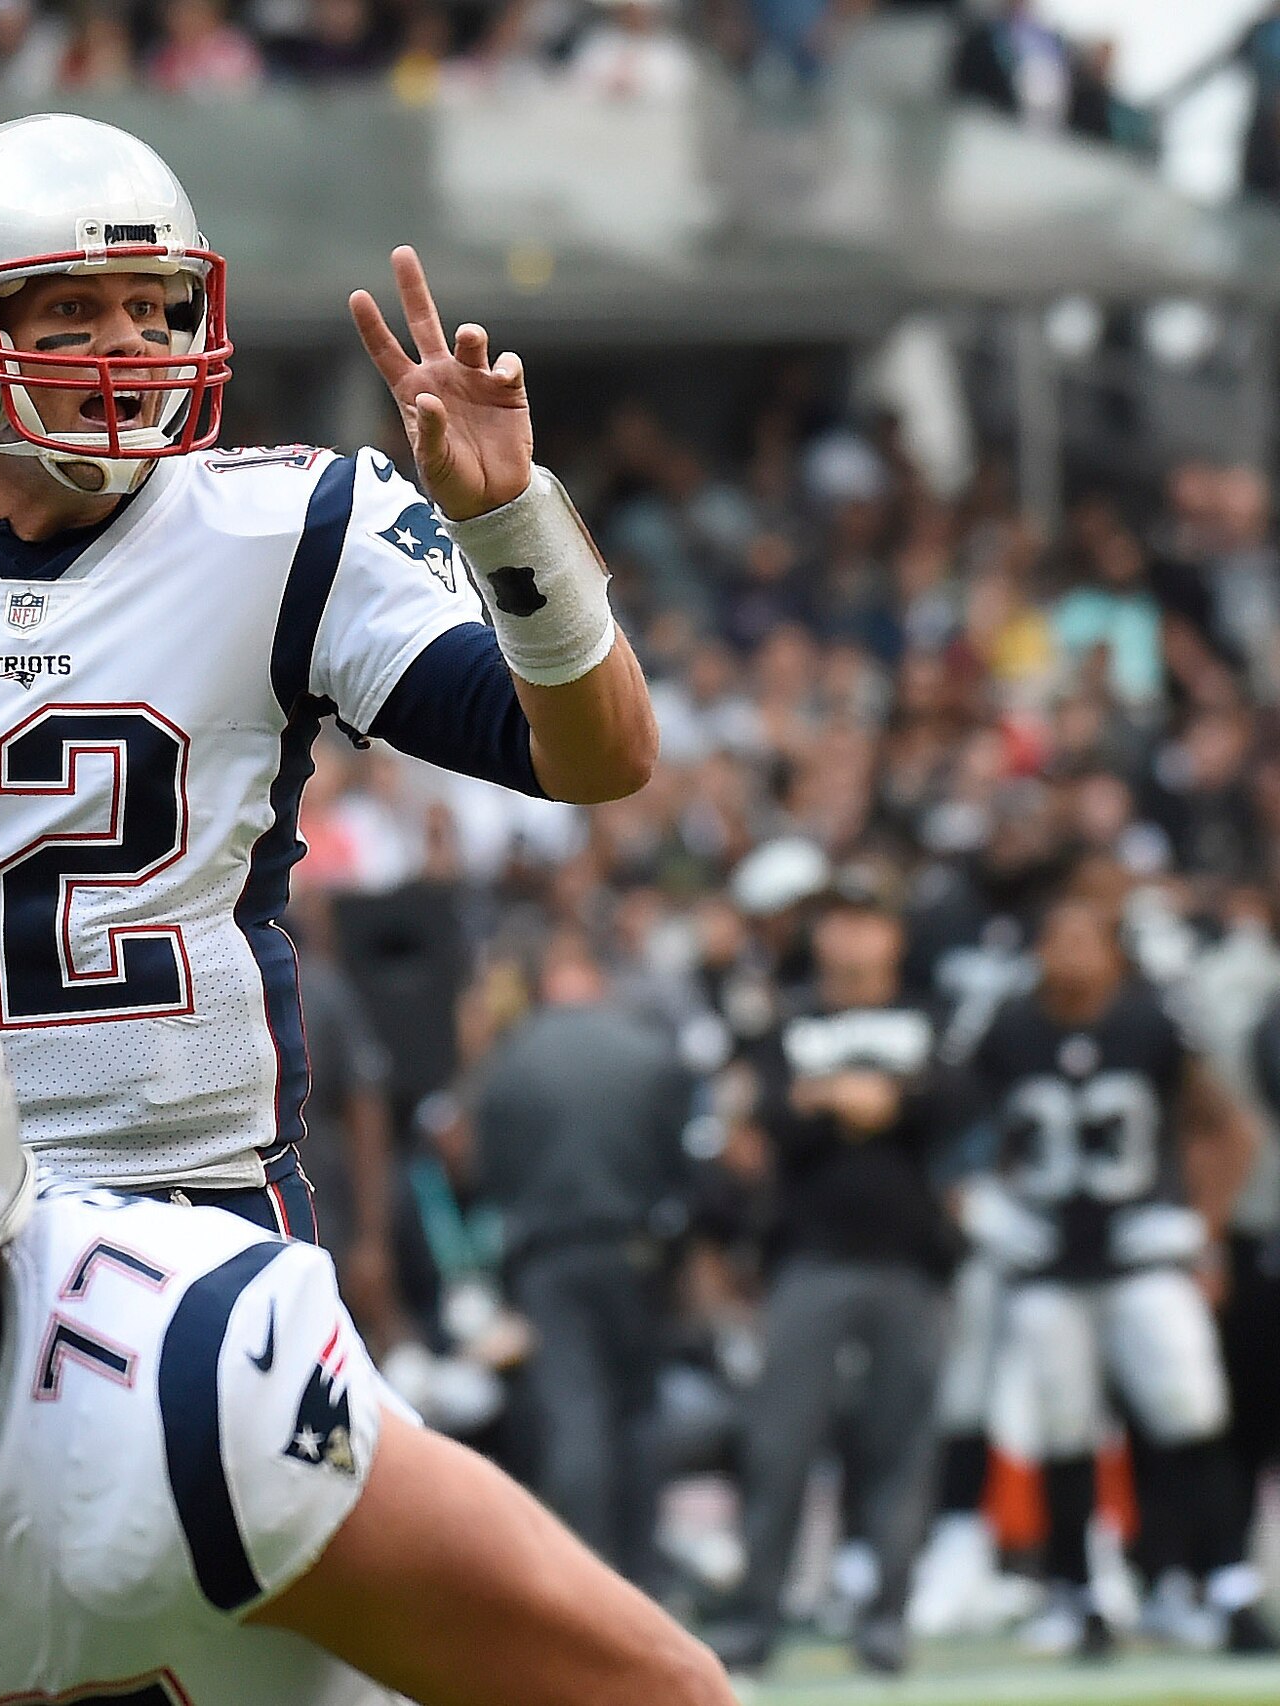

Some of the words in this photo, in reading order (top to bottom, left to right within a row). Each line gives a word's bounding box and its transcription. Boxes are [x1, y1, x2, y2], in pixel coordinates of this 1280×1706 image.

[104, 224, 157, 245] PATRIOTS
[11, 608, 38, 624] NFL
[31, 1236, 177, 1402] 77
